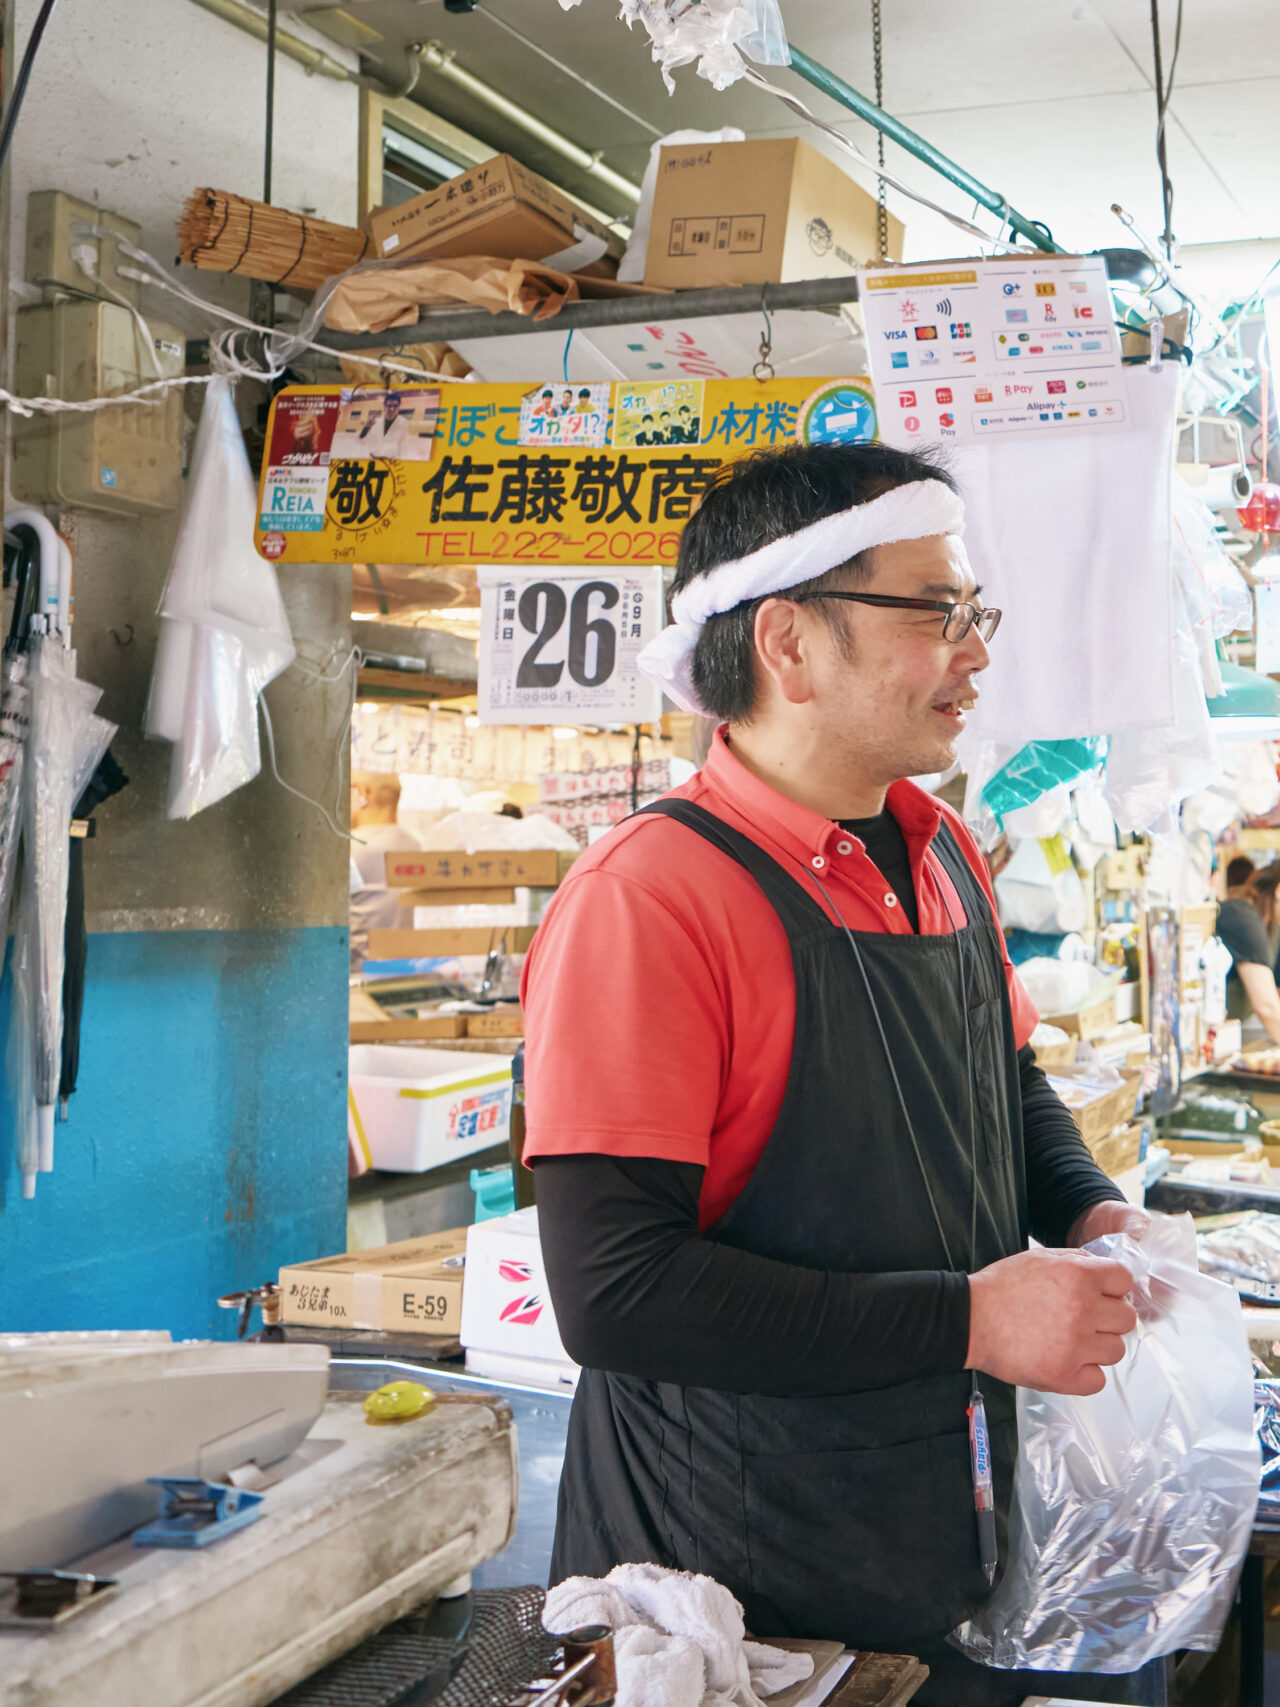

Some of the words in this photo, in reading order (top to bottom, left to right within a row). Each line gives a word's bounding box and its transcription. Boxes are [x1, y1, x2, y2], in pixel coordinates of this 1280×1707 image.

[884, 330, 908, 341] VISA
[1013, 384, 1034, 396] Pay
[1027, 401, 1056, 413] Alipay
[940, 428, 957, 437] Pay
[271, 486, 315, 512] REIA
[330, 461, 389, 524] 敬
[516, 581, 620, 688] 26
[289, 1284, 331, 1299] あじたま
[402, 1293, 448, 1317] E-59
[976, 1428, 987, 1475] Players
